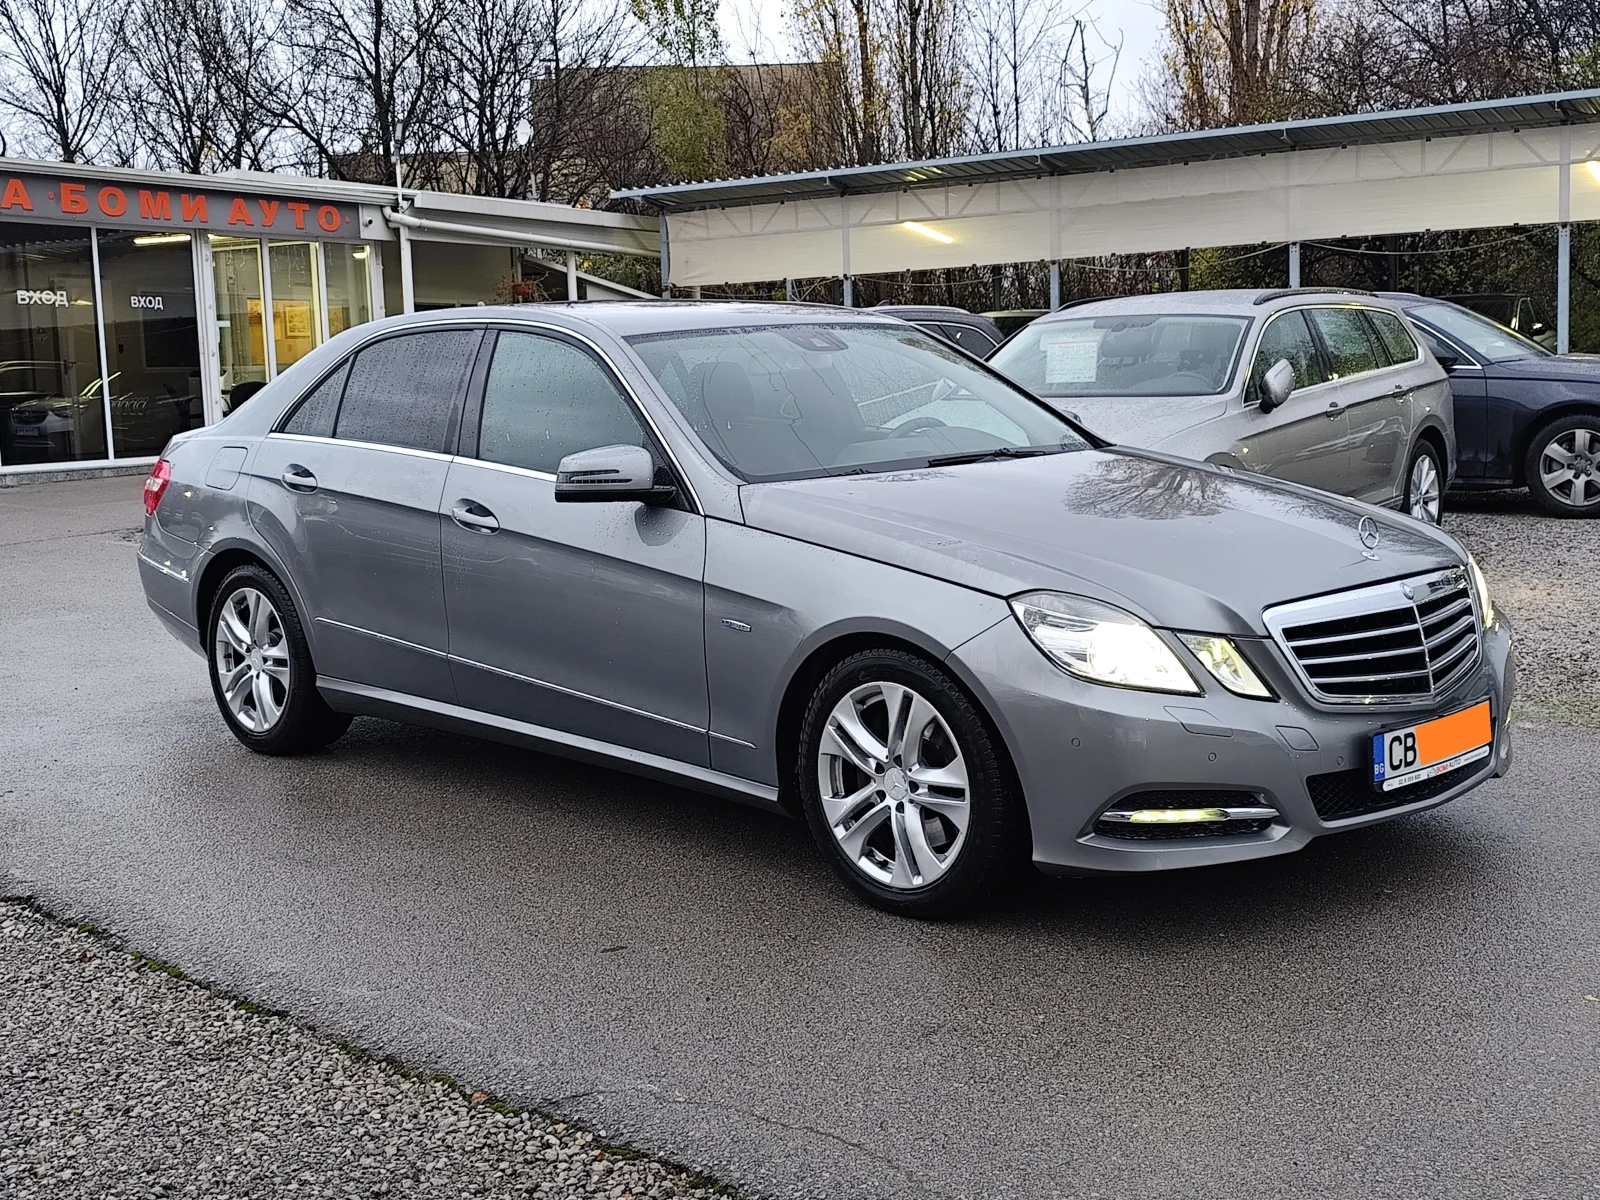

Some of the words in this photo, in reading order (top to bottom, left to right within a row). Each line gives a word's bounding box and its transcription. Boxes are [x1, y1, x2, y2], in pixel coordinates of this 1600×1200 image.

[60, 182, 208, 223] БОМИ
[228, 198, 341, 232] АУТО
[16, 289, 69, 307] ВХОД
[130, 295, 164, 311] ВХОД
[1374, 763, 1385, 775] BG
[1449, 758, 1462, 768] AUTO
